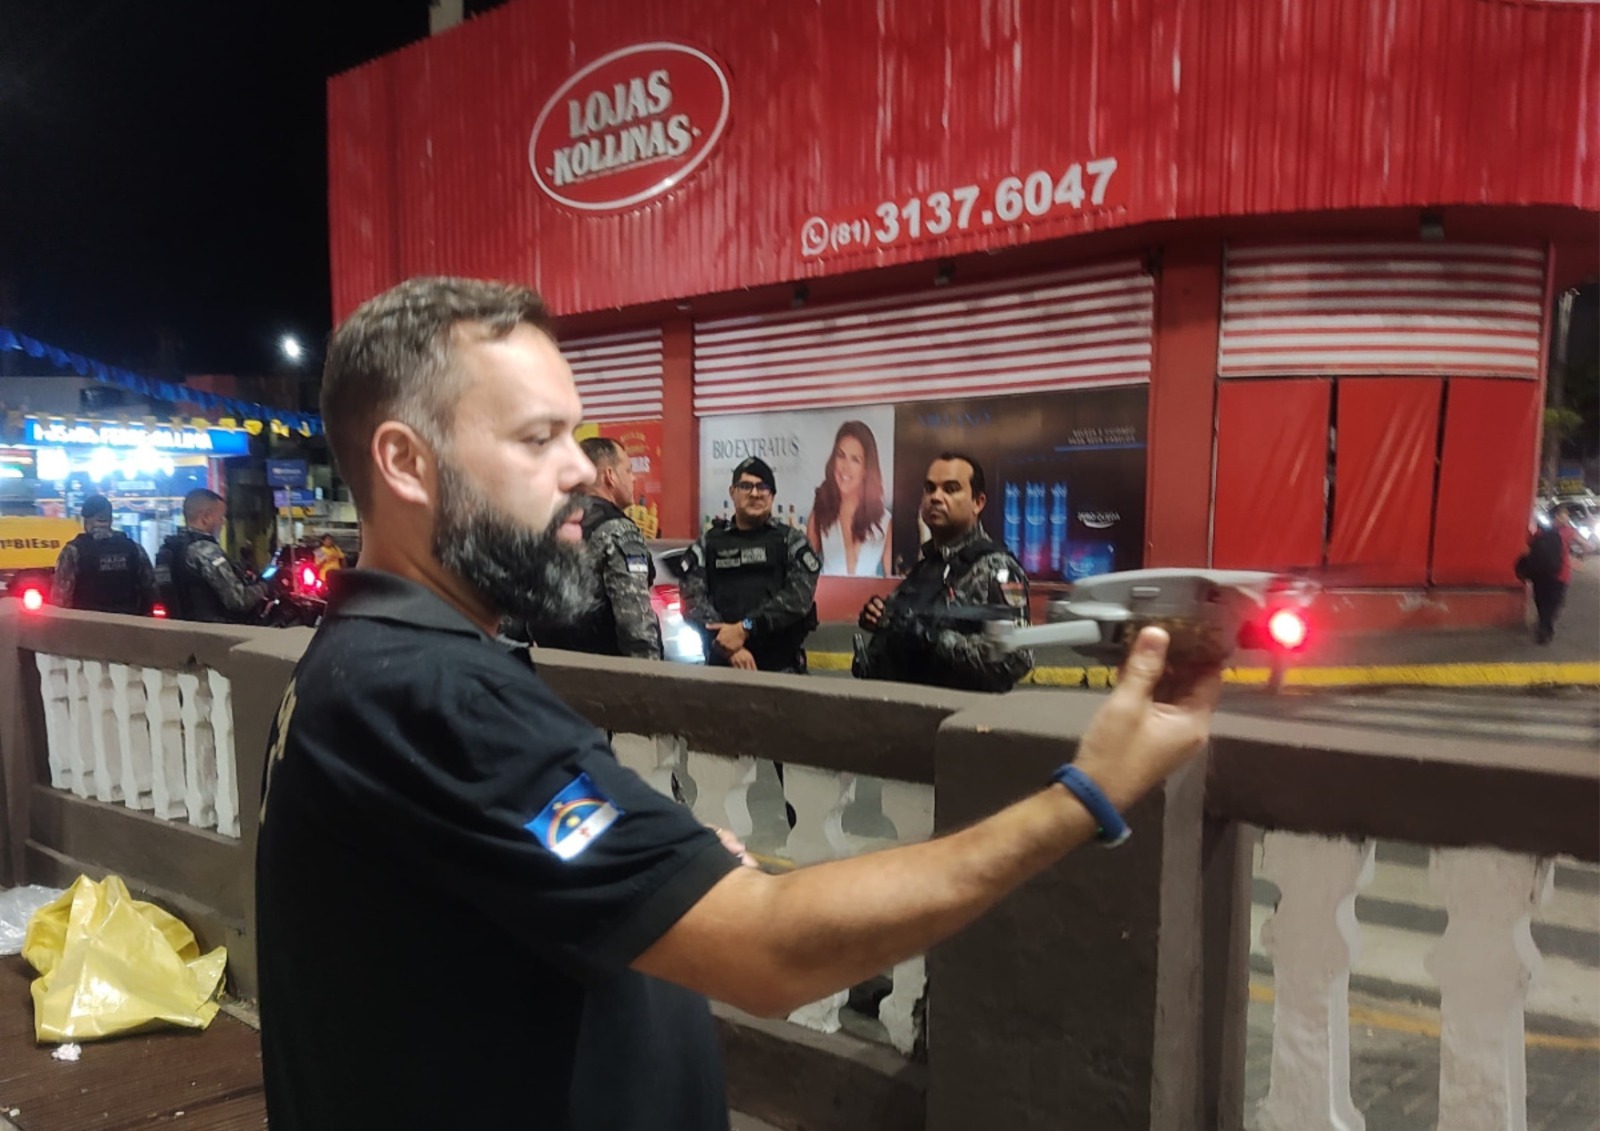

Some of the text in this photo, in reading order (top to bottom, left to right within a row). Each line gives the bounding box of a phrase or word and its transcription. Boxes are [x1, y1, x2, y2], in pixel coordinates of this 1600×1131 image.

[567, 68, 673, 139] LOJAS
[552, 113, 693, 187] KOLLINAS
[830, 156, 1118, 251] (81) 3137.6047
